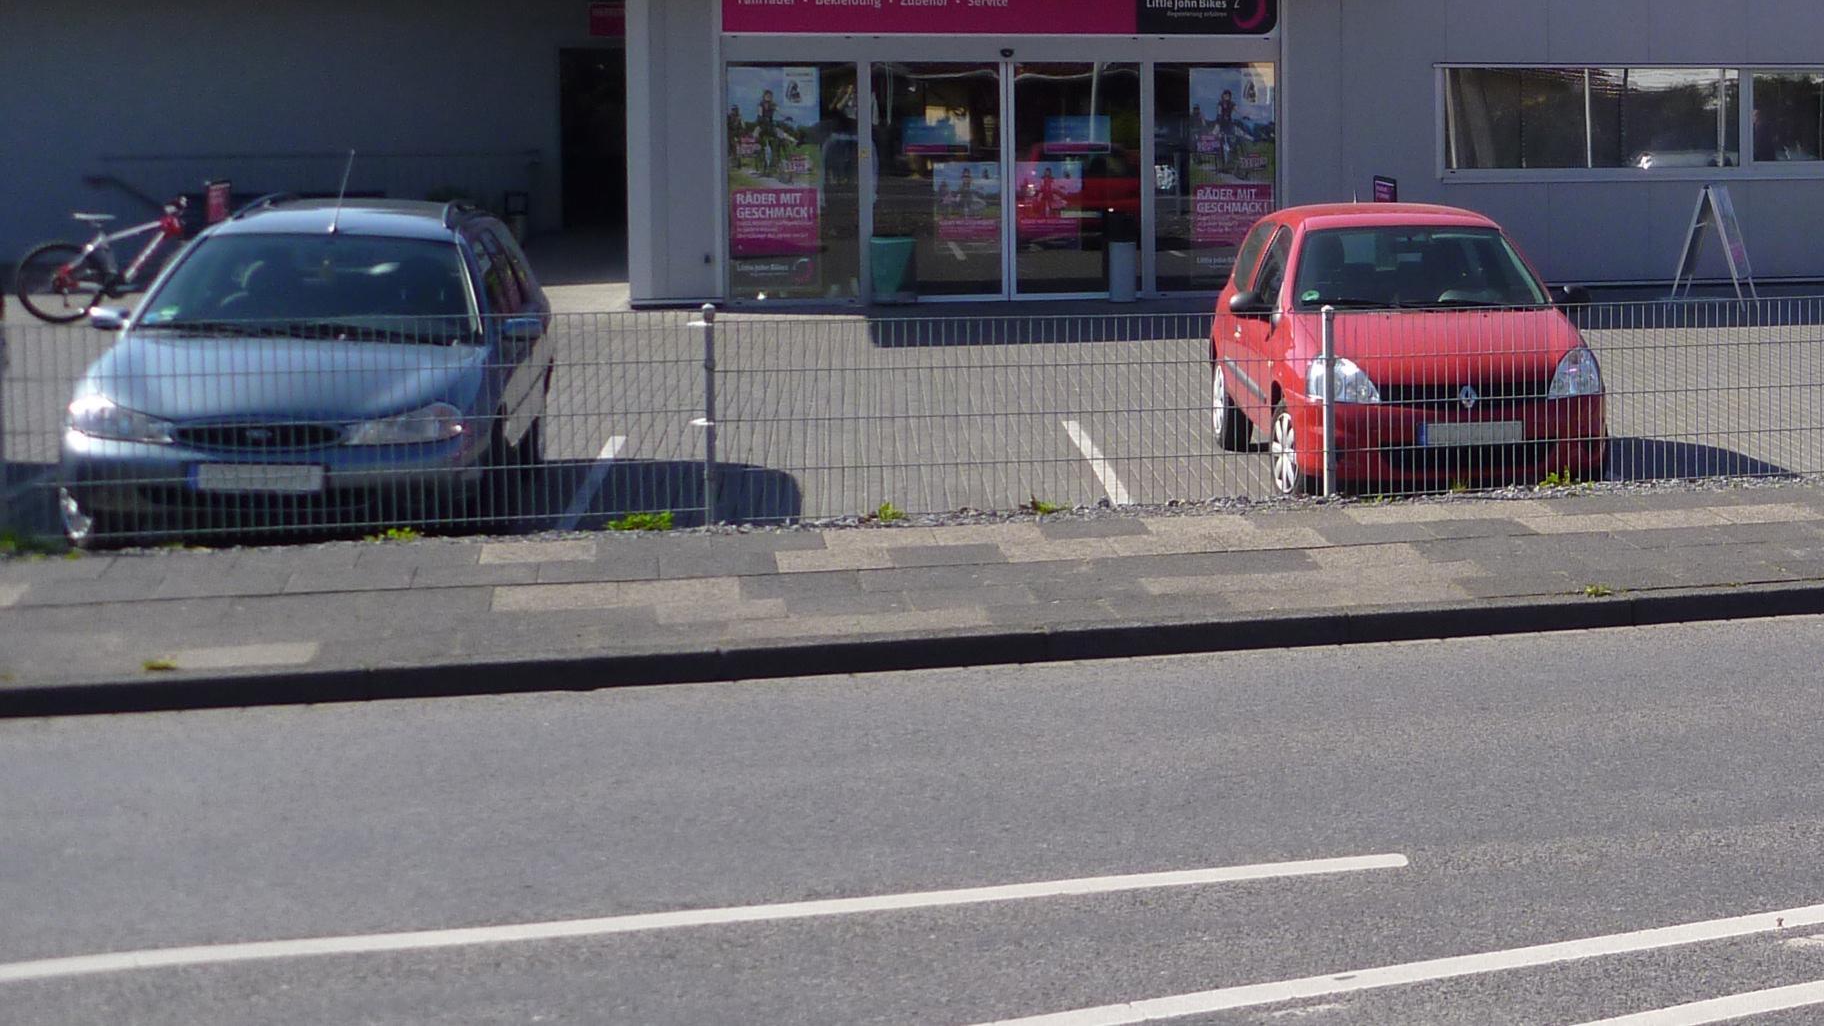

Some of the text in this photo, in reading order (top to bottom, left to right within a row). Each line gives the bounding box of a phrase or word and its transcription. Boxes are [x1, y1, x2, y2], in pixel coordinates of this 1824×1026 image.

[736, 191, 802, 205] RÄDER MIT
[1197, 187, 1257, 200] RÄDER MIT
[736, 206, 813, 219] GESCHMACK!
